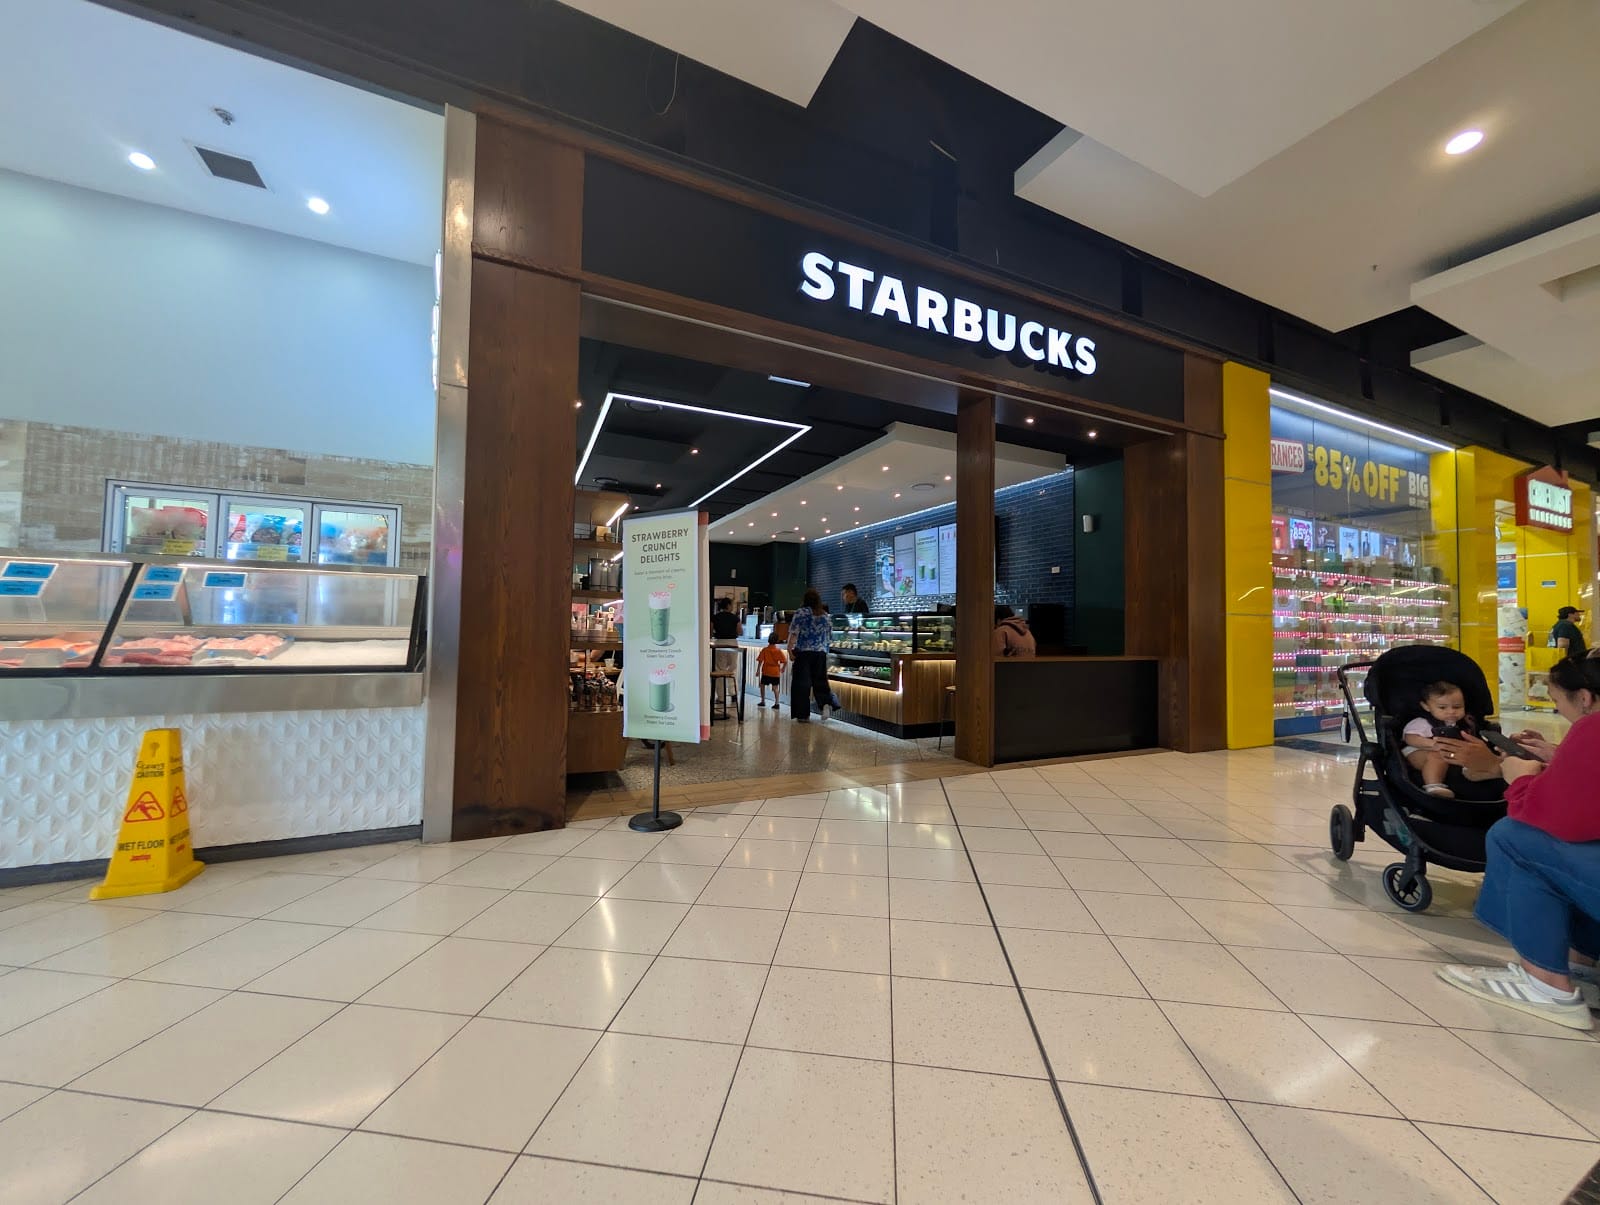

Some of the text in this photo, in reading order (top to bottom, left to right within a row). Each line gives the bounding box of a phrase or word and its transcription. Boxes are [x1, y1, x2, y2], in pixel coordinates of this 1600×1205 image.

[800, 252, 1098, 376] STARBUCKS
[1314, 446, 1400, 503] 85% OFF
[1408, 472, 1429, 497] BIG
[631, 528, 689, 543] STRAWBERRY
[642, 541, 677, 552] CRUNCH
[640, 552, 681, 564] DELIGHTS
[118, 841, 137, 852] WET
[137, 839, 165, 850] FLOOR
